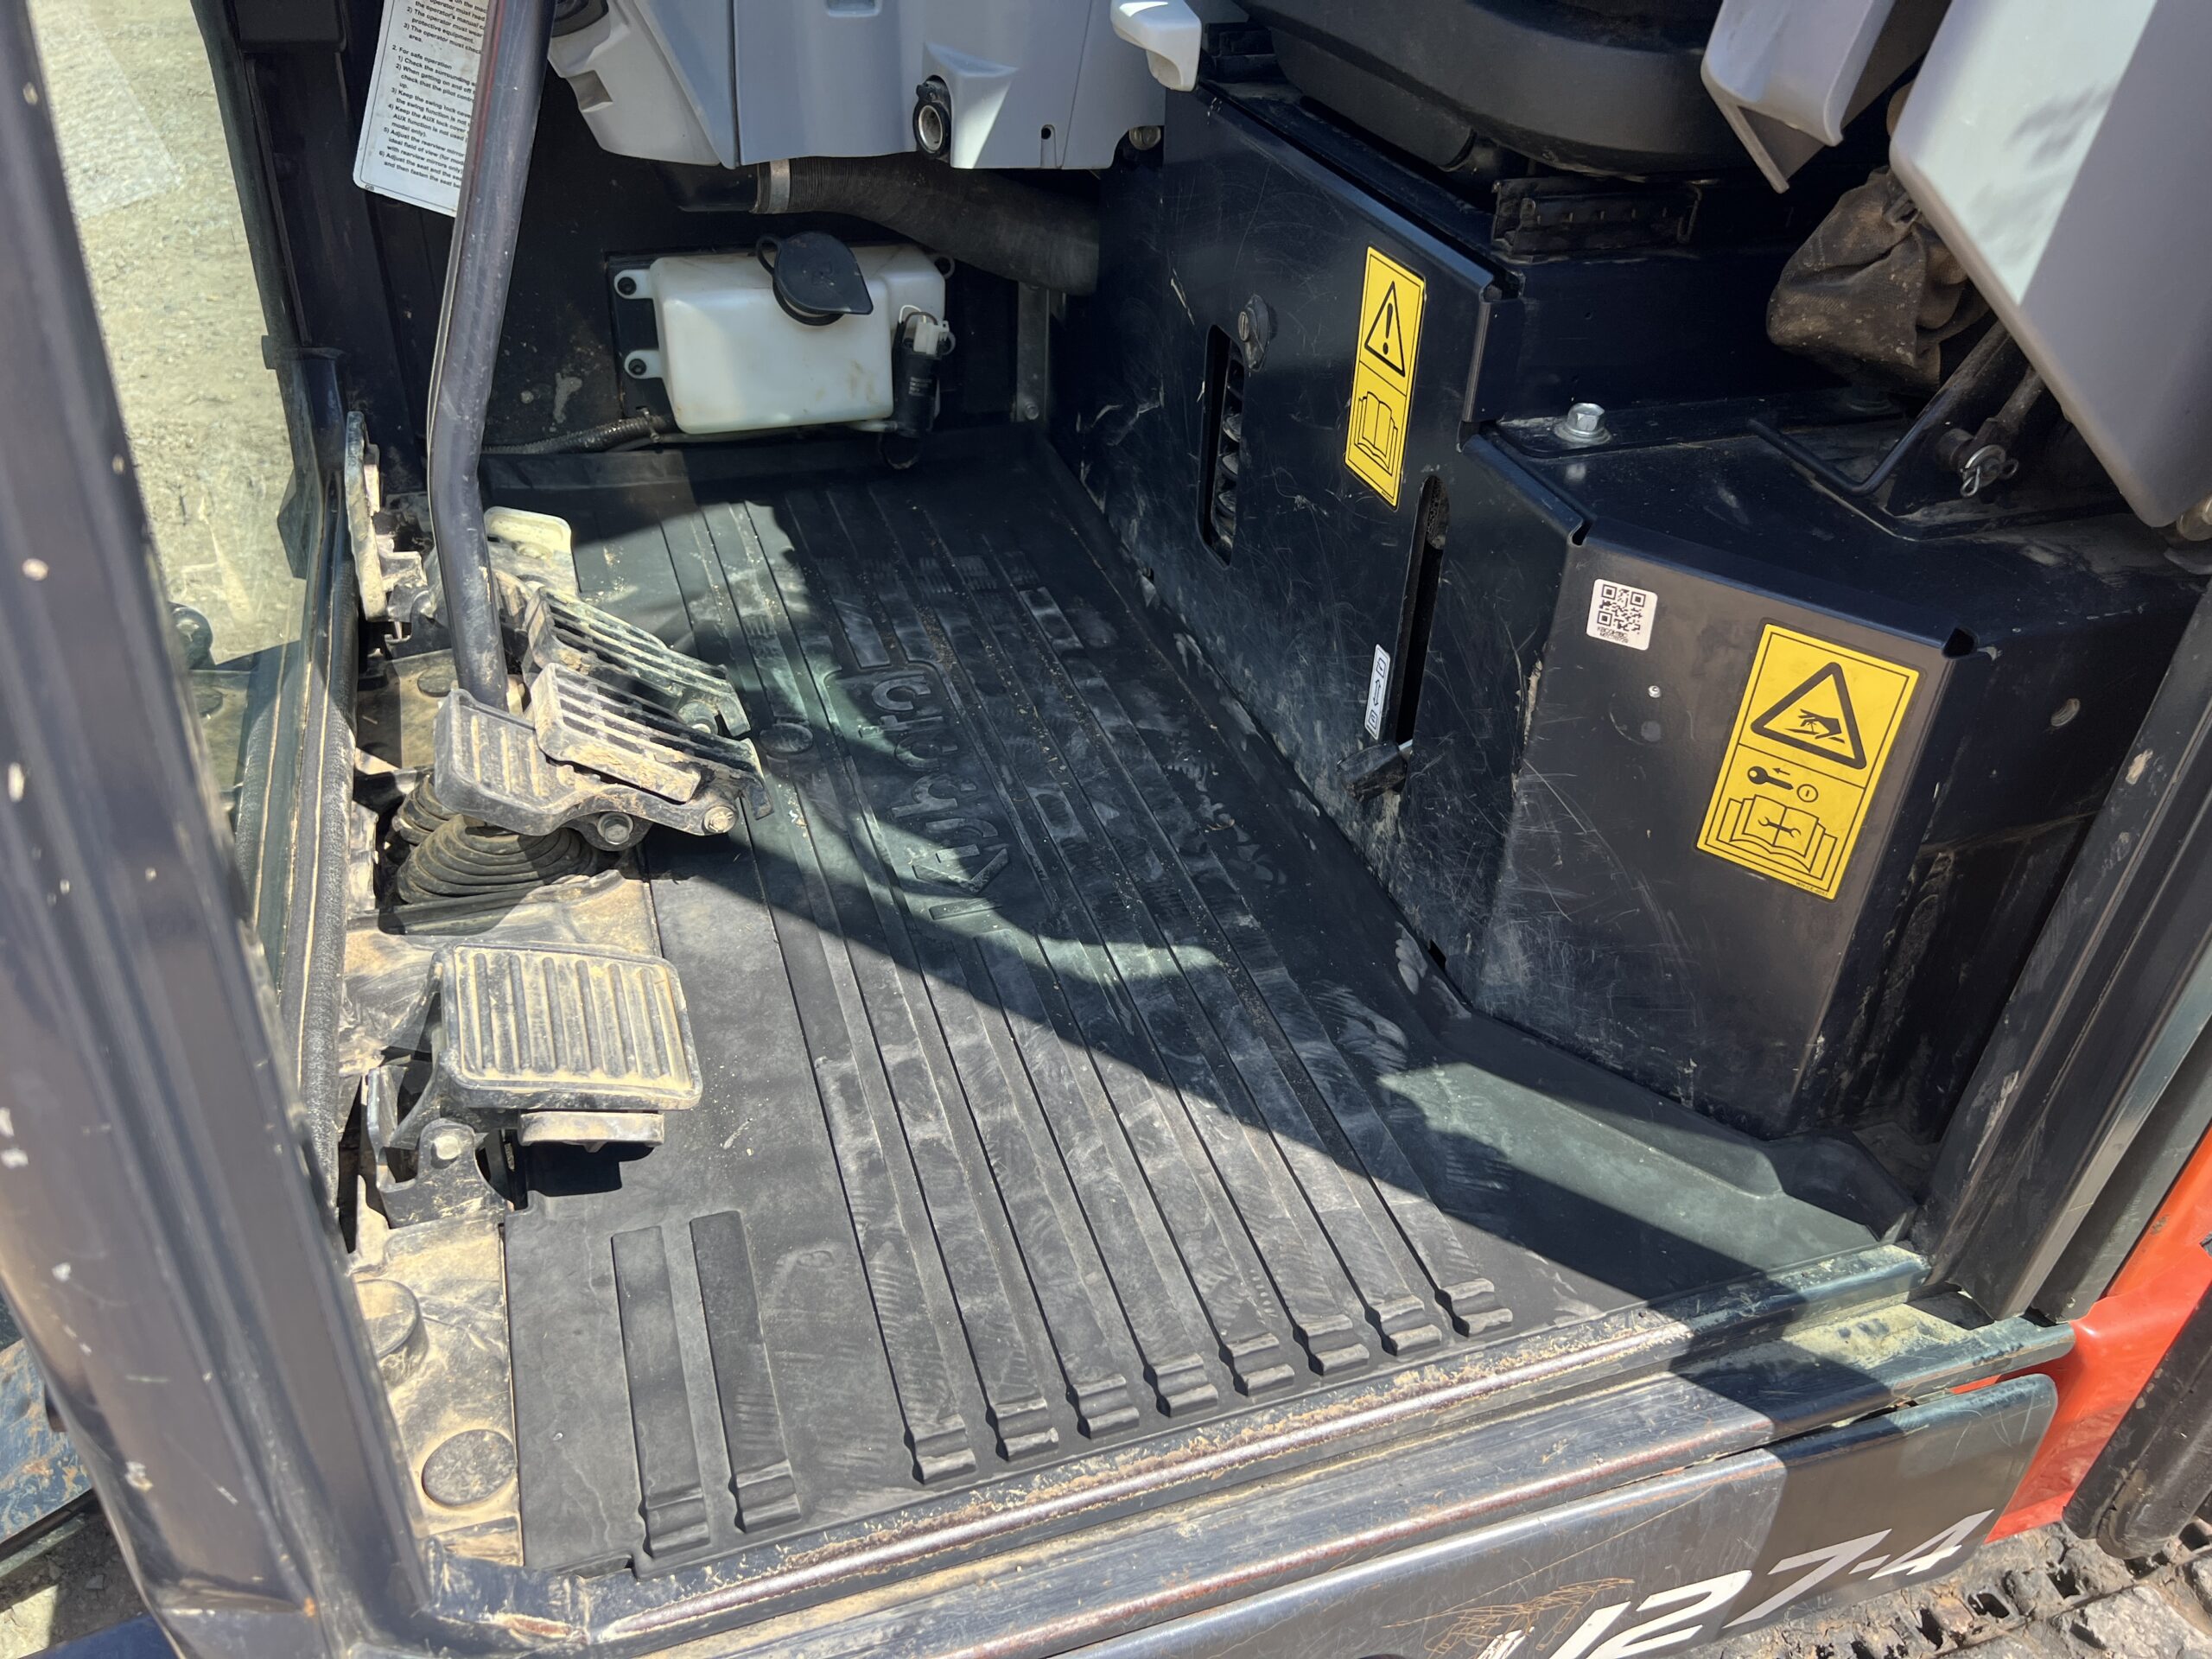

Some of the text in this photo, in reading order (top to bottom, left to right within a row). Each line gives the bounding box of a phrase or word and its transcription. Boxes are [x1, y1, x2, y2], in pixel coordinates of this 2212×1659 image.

[415, 9, 425, 17] The
[427, 15, 452, 26] operator
[426, 5, 455, 19] operator's
[457, 16, 479, 28] manual
[455, 8, 471, 16] must
[472, 13, 485, 22] read
[474, 5, 487, 14] mac
[412, 18, 474, 44] protective equipment.
[423, 31, 448, 41] operator
[449, 40, 464, 48] must
[404, 58, 423, 68] Check
[435, 69, 470, 86] surrounding
[424, 57, 452, 70] operation
[404, 66, 419, 75] When
[421, 73, 442, 84] getting
[401, 74, 418, 84] check
[457, 94, 474, 103] contr
[395, 105, 410, 115] Keep
[398, 90, 413, 99] Keep
[425, 100, 442, 110] swing
[444, 105, 456, 113] lock
[407, 102, 424, 112] swing
[426, 107, 449, 119] function
[391, 122, 410, 131] model
[393, 113, 406, 122] AUX
[408, 118, 431, 130] function
[391, 130, 410, 140] Adjust
[422, 141, 446, 151] rearview
[447, 149, 464, 157] mirror
[404, 142, 416, 150] field
[386, 153, 405, 163] Adjust
[401, 150, 425, 161] rearview
[426, 159, 447, 168] mirrors
[410, 168, 428, 178] fasten
